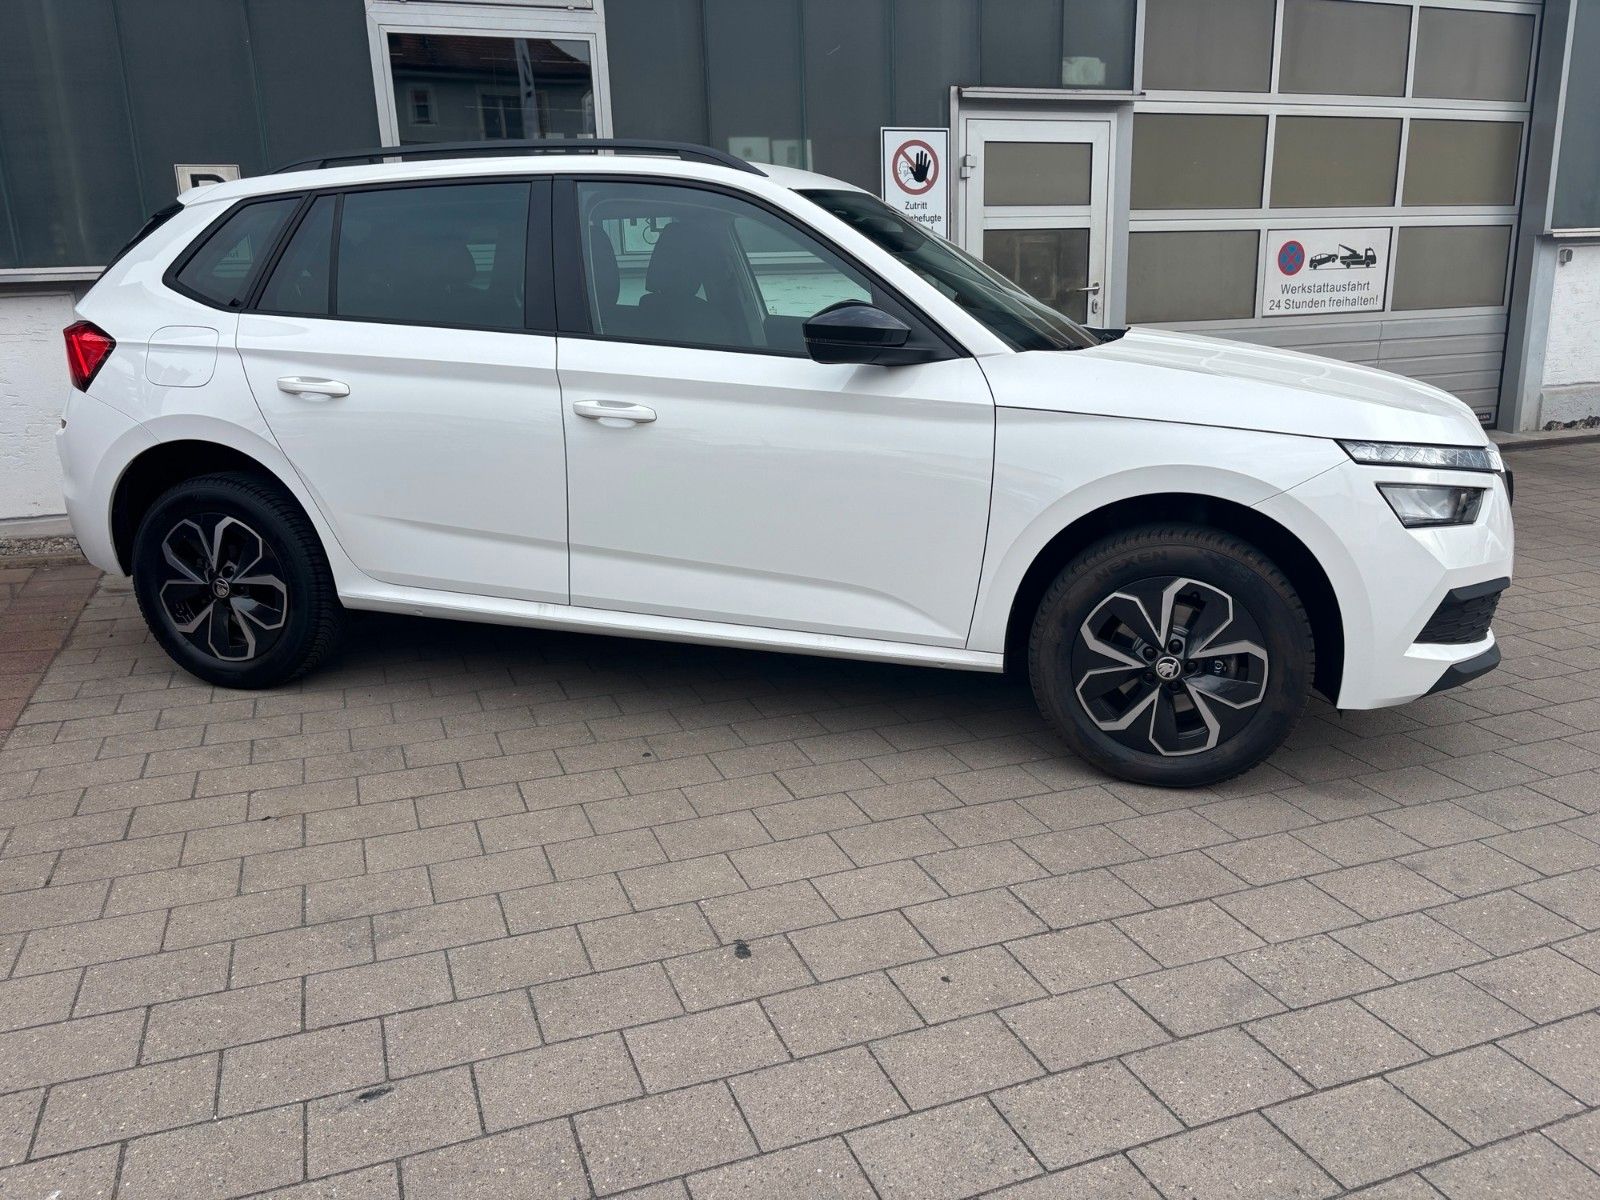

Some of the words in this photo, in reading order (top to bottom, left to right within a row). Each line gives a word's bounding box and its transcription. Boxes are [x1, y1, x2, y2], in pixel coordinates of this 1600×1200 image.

[905, 201, 928, 210] Zutritt
[1280, 281, 1370, 294] Werkstattausfahrt
[1268, 300, 1281, 310] 24
[1284, 298, 1326, 310] Stunden
[1328, 295, 1379, 308] freihalten!
